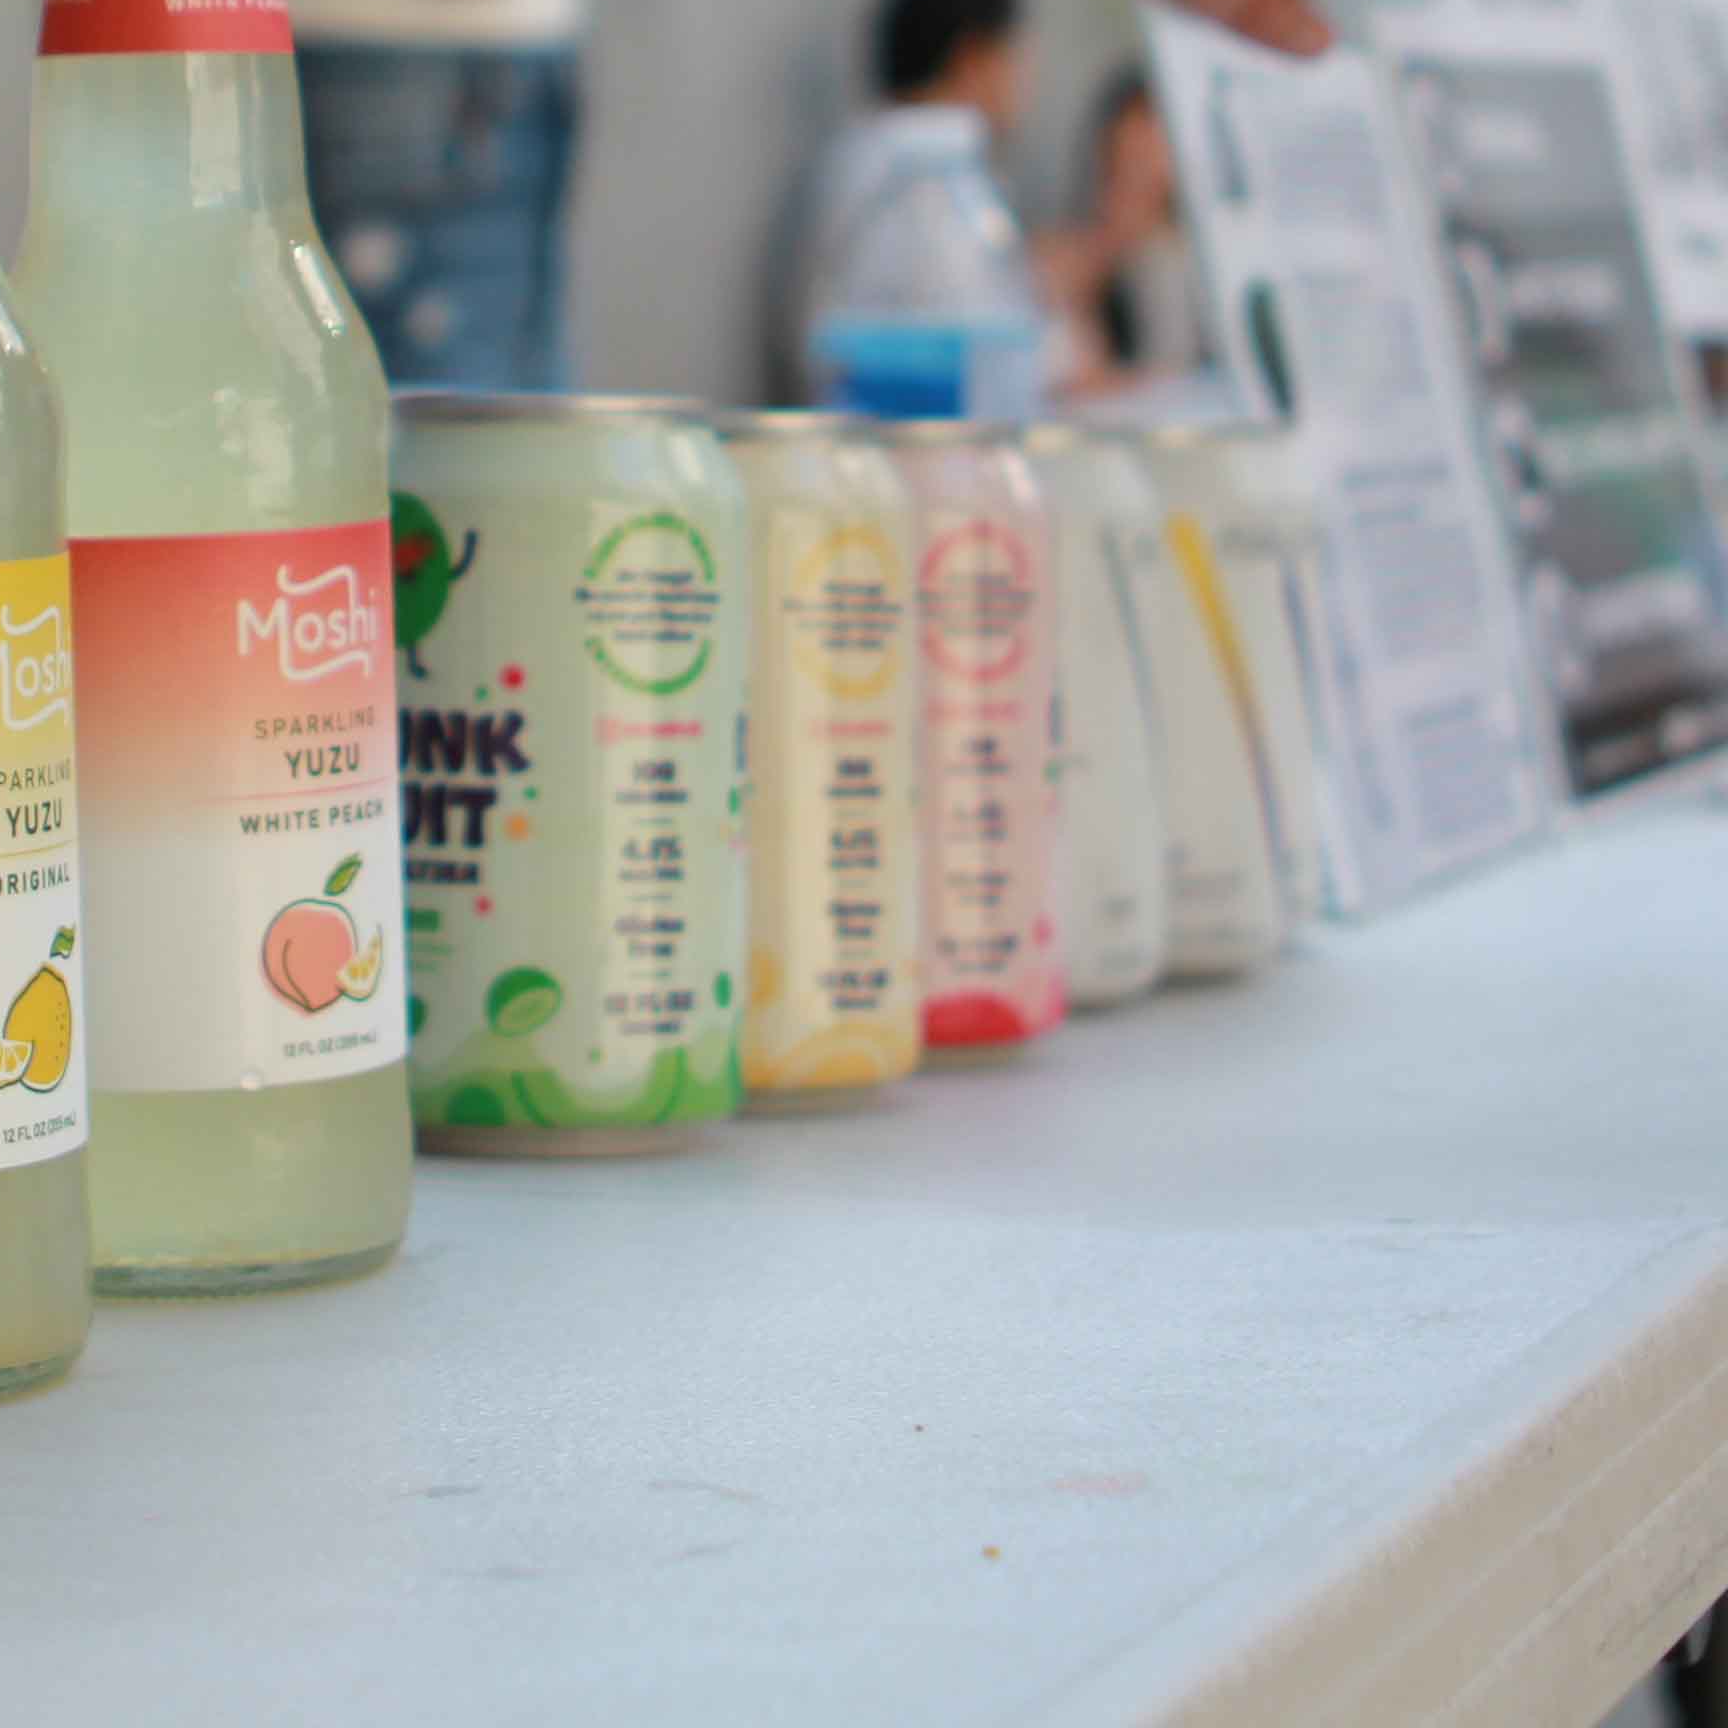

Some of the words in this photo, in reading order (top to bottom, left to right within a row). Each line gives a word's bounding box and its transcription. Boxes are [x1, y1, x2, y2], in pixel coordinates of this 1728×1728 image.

[236, 563, 381, 683] Moshi
[253, 705, 377, 739] SPARKLING
[284, 742, 361, 779] YUZU
[5, 798, 63, 839] YUZU
[239, 808, 321, 835] WHITE
[328, 798, 384, 828] PEACH
